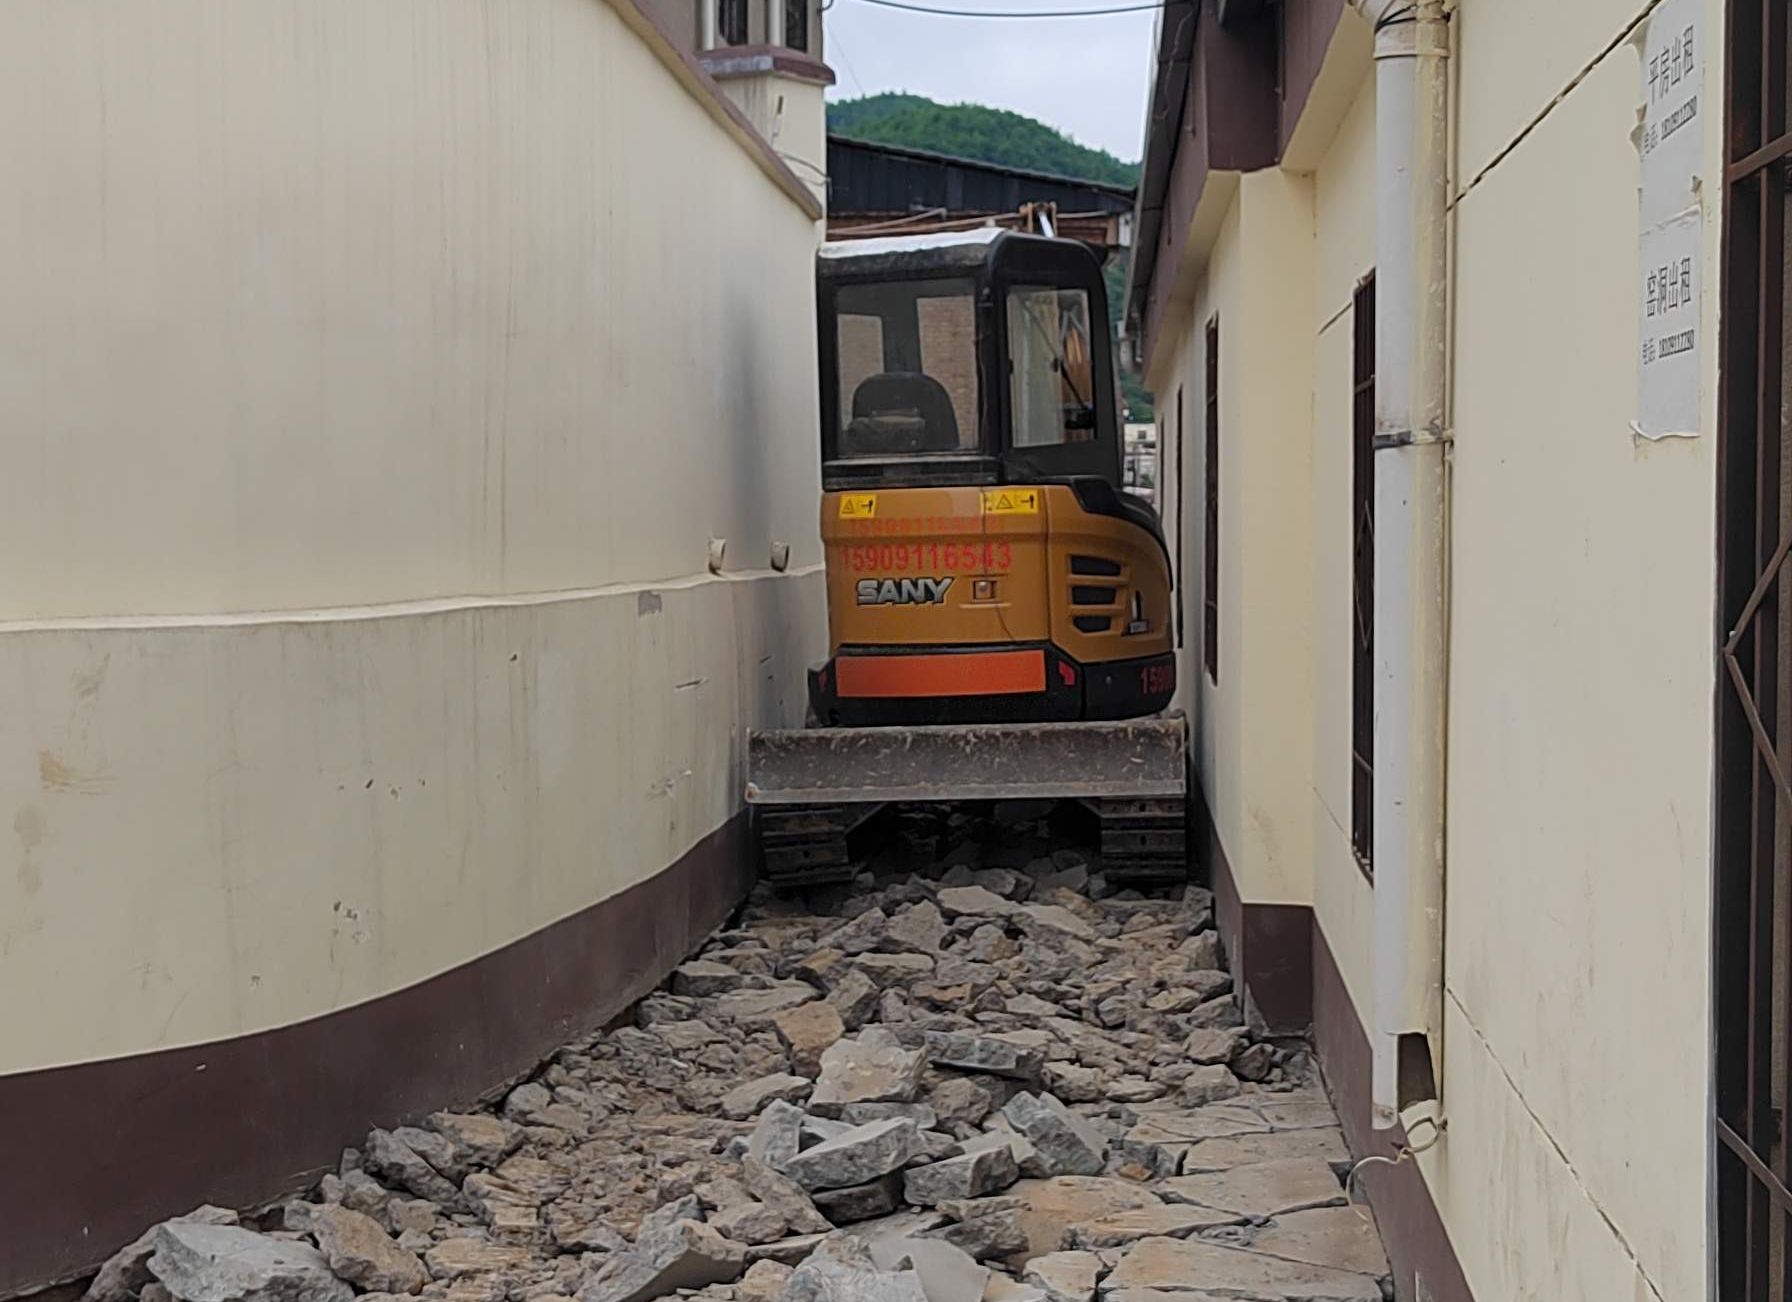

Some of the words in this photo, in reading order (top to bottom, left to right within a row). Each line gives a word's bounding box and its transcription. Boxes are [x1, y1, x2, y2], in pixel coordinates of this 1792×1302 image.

[1647, 24, 1694, 105] 平房出租
[1646, 256, 1691, 317] 窑洞出租
[840, 542, 1013, 571] 15909116543
[857, 577, 953, 605] SANY
